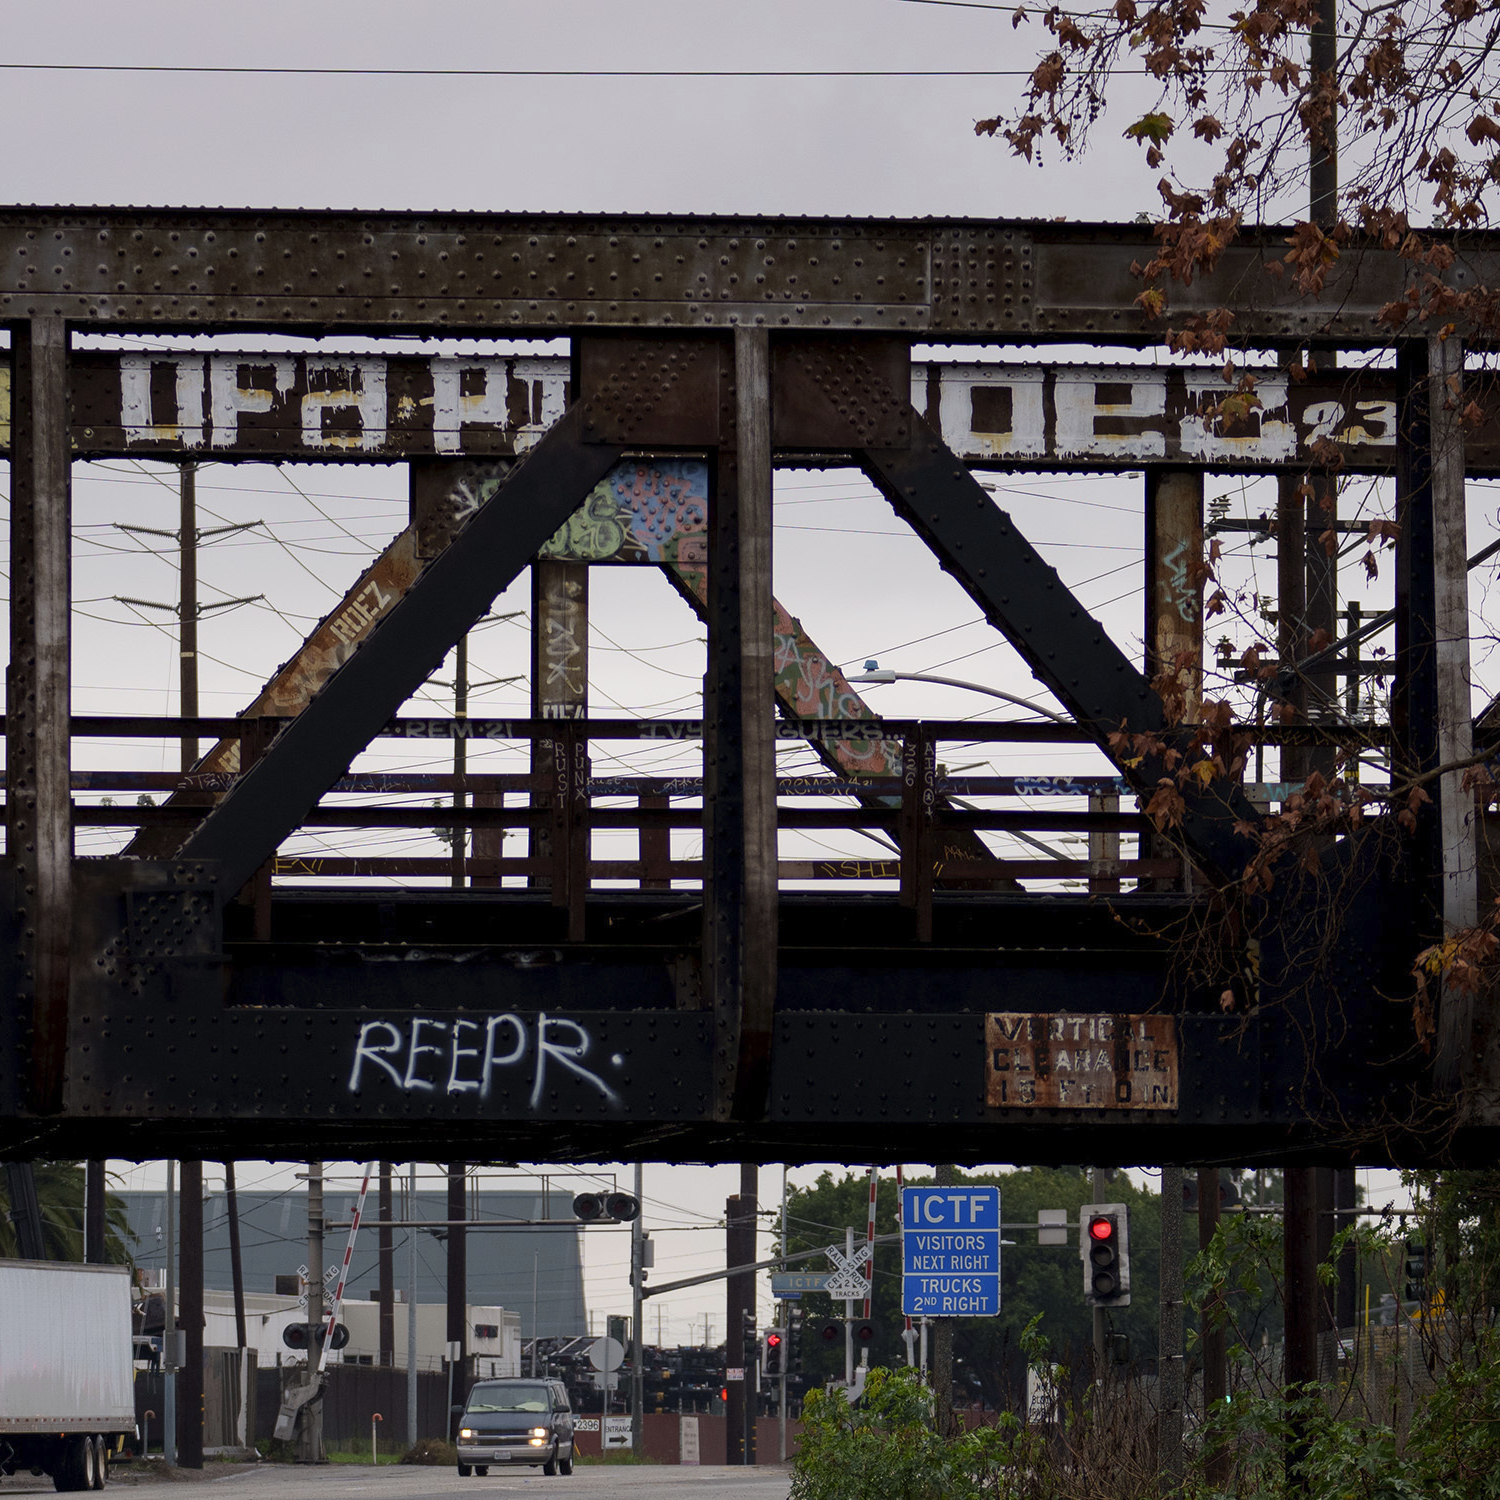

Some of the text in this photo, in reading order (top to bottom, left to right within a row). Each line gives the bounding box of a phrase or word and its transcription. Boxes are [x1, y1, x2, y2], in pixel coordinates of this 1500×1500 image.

[913, 1195, 990, 1223] ICTF
[916, 1236, 986, 1250] VISITORS
[913, 1255, 990, 1270] NEXT RIGHT
[788, 1278, 822, 1287] ICTF
[844, 1279, 851, 1287] 2
[920, 1279, 982, 1293] TRUCKS
[913, 1297, 989, 1311] 2ND RIGHT
[577, 1420, 599, 1430] 2396
